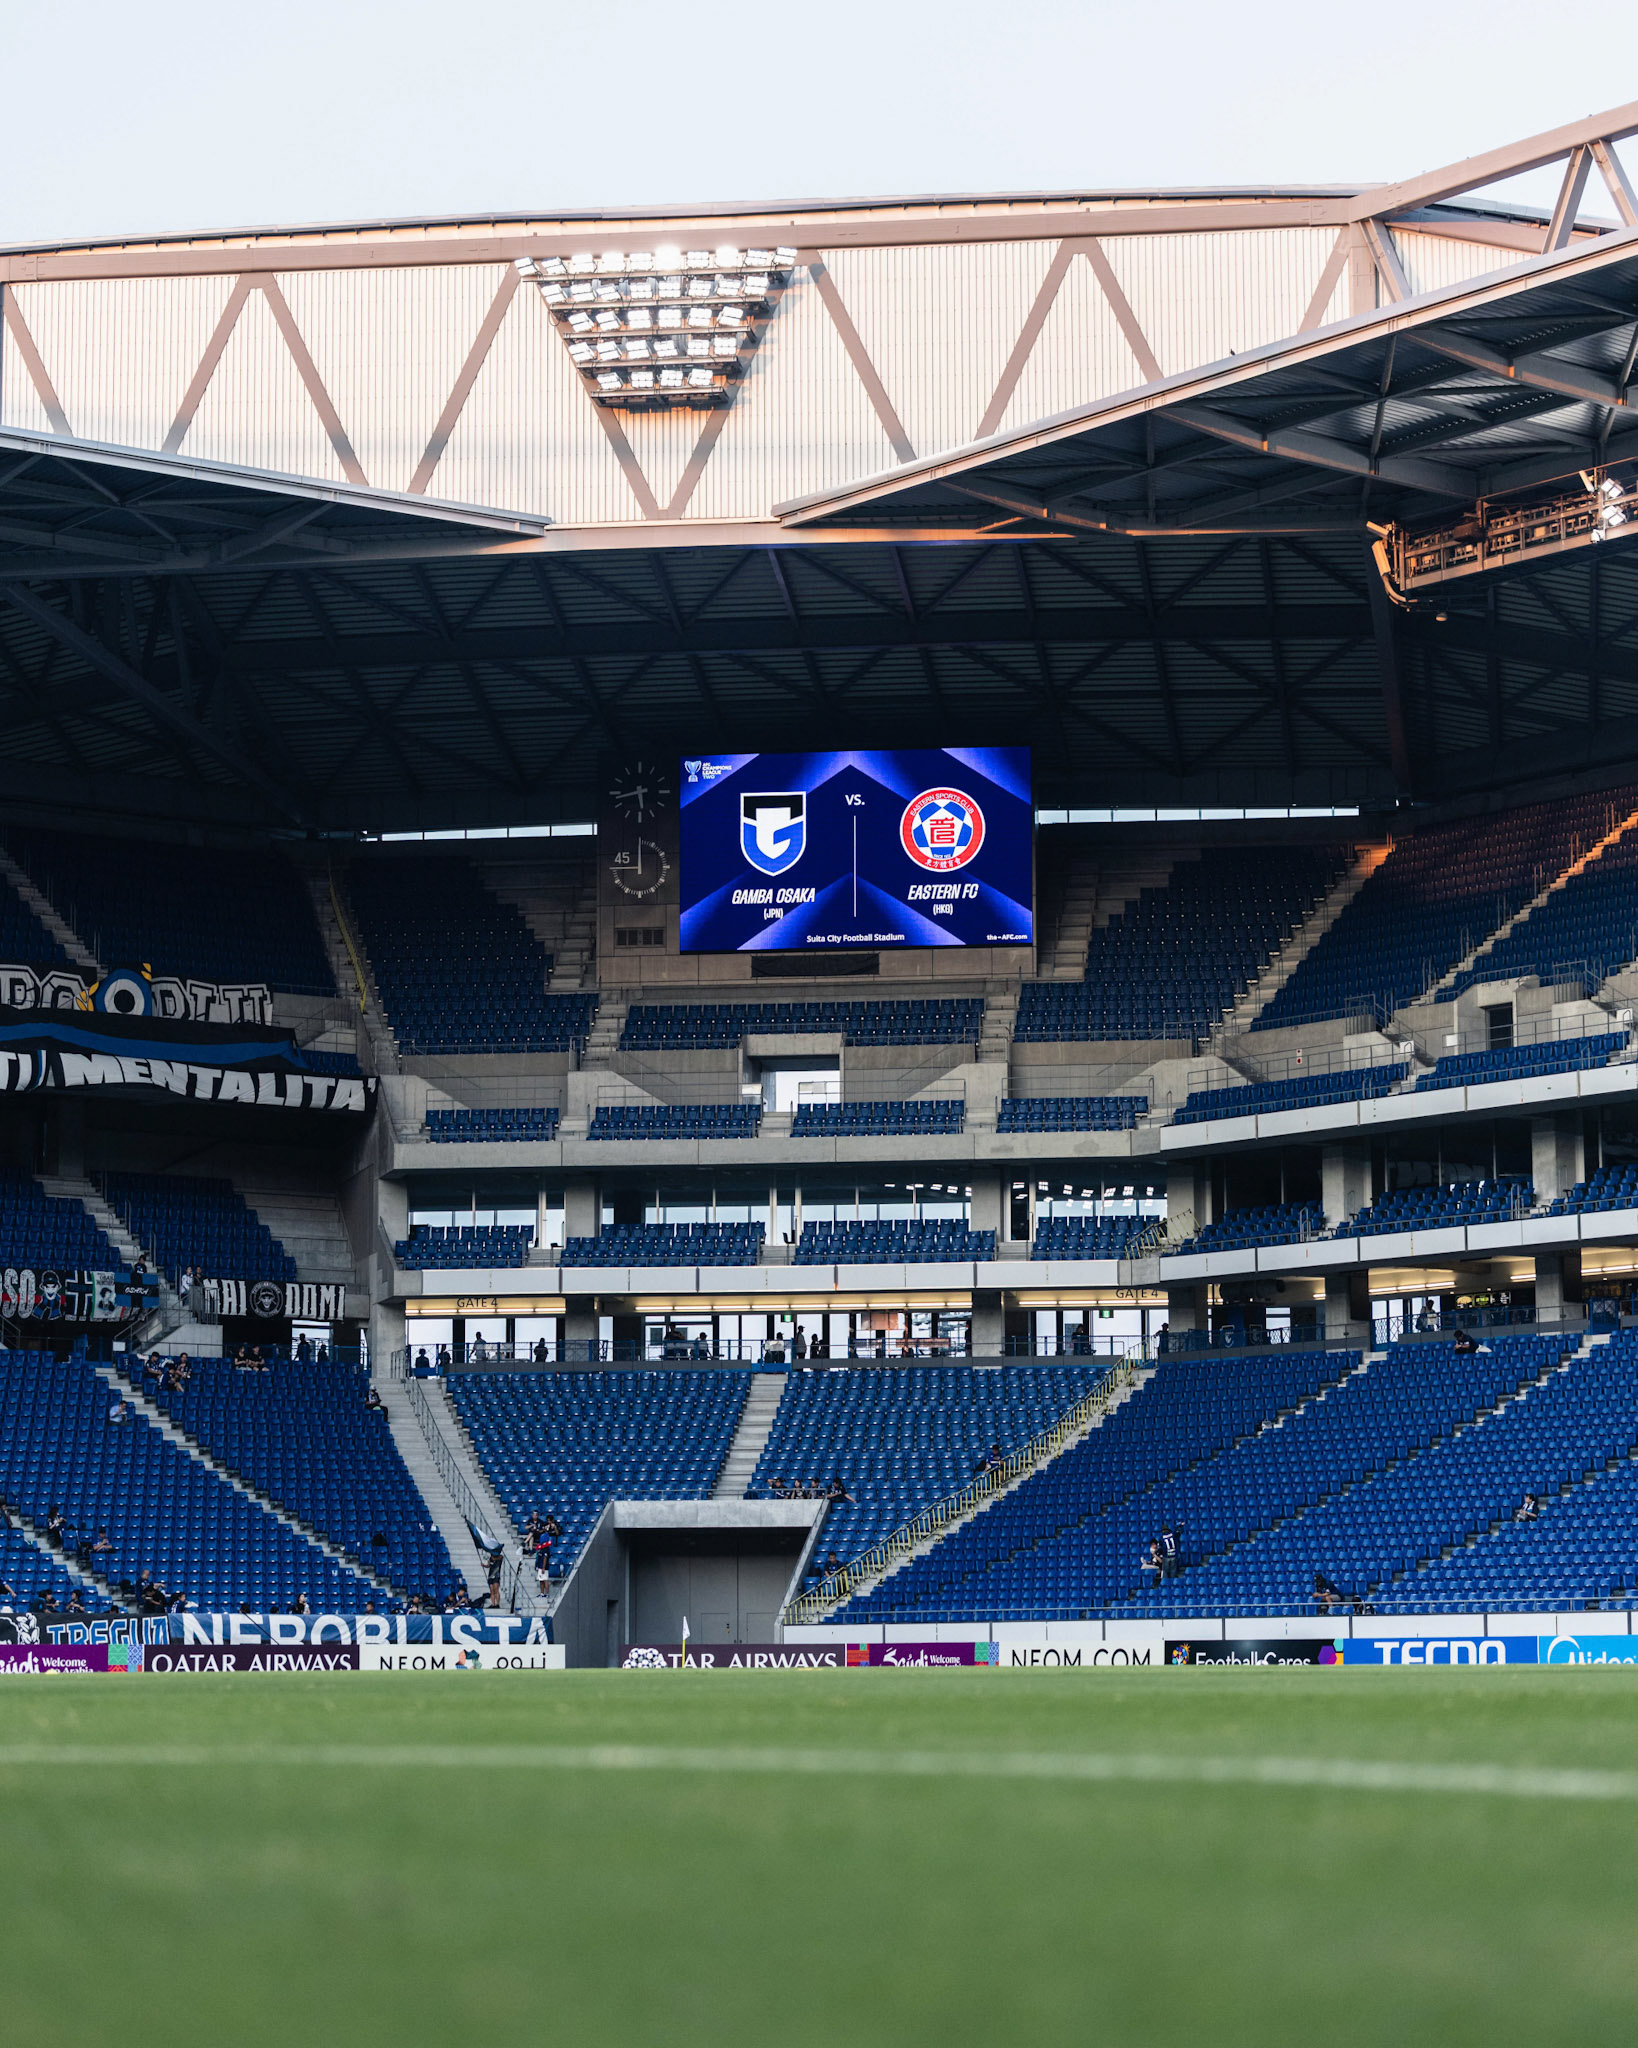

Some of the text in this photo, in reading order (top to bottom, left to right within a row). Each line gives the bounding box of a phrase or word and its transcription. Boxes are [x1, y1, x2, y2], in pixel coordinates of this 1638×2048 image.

[845, 794, 865, 805] VS.
[910, 793, 975, 816] EASTERN SPORTS CLUB
[614, 852, 630, 864] 45
[732, 888, 816, 904] GAMBA OSAKA
[907, 883, 979, 900] EASTERN FC
[763, 907, 784, 920] (JPN)
[932, 903, 954, 916] (HKG)
[826, 935, 842, 944] City
[843, 934, 873, 942] Football
[874, 933, 905, 941] Stadium
[1116, 1288, 1147, 1298] GATE
[457, 1297, 498, 1308] GATE 4
[42, 1657, 87, 1667] Welcome
[152, 1654, 352, 1672] QATAR AIRWAYS
[380, 1656, 446, 1670] NEOM
[728, 1653, 837, 1668] AIRWAYS
[930, 1655, 961, 1664] Welcome
